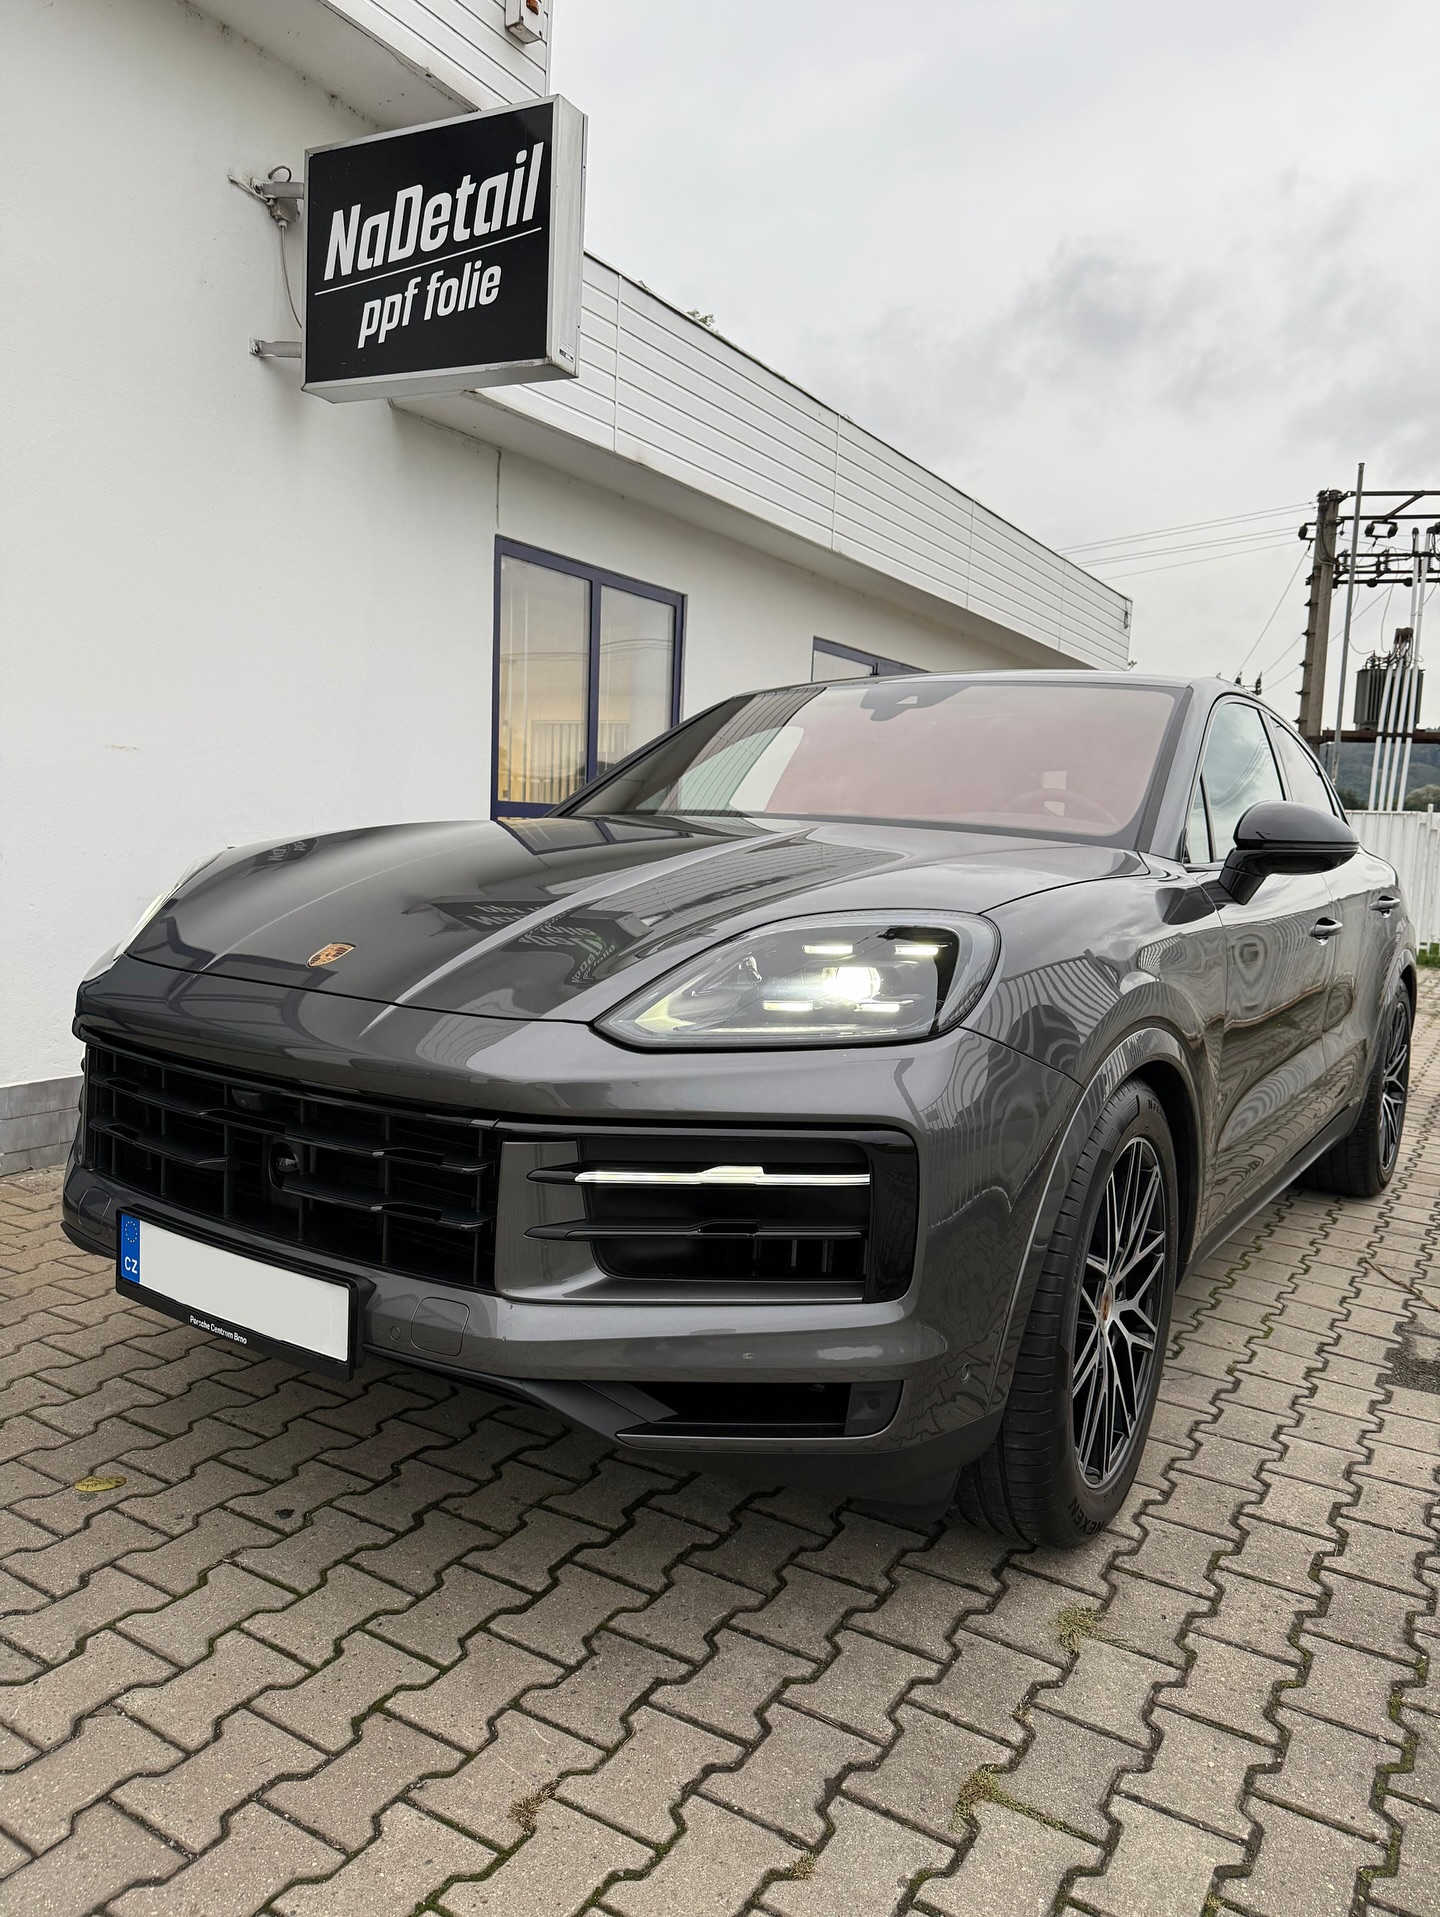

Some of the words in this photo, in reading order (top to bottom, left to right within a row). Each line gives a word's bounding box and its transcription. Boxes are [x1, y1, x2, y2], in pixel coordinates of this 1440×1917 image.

[323, 141, 544, 281] NaDetail
[357, 276, 422, 349] ppf
[423, 260, 501, 321] folie
[124, 1256, 138, 1274] CZ
[190, 1315, 210, 1330] Porsche
[210, 1323, 234, 1339] Centrum
[233, 1332, 248, 1345] Brno
[1068, 1496, 1105, 1536] NEXEN
